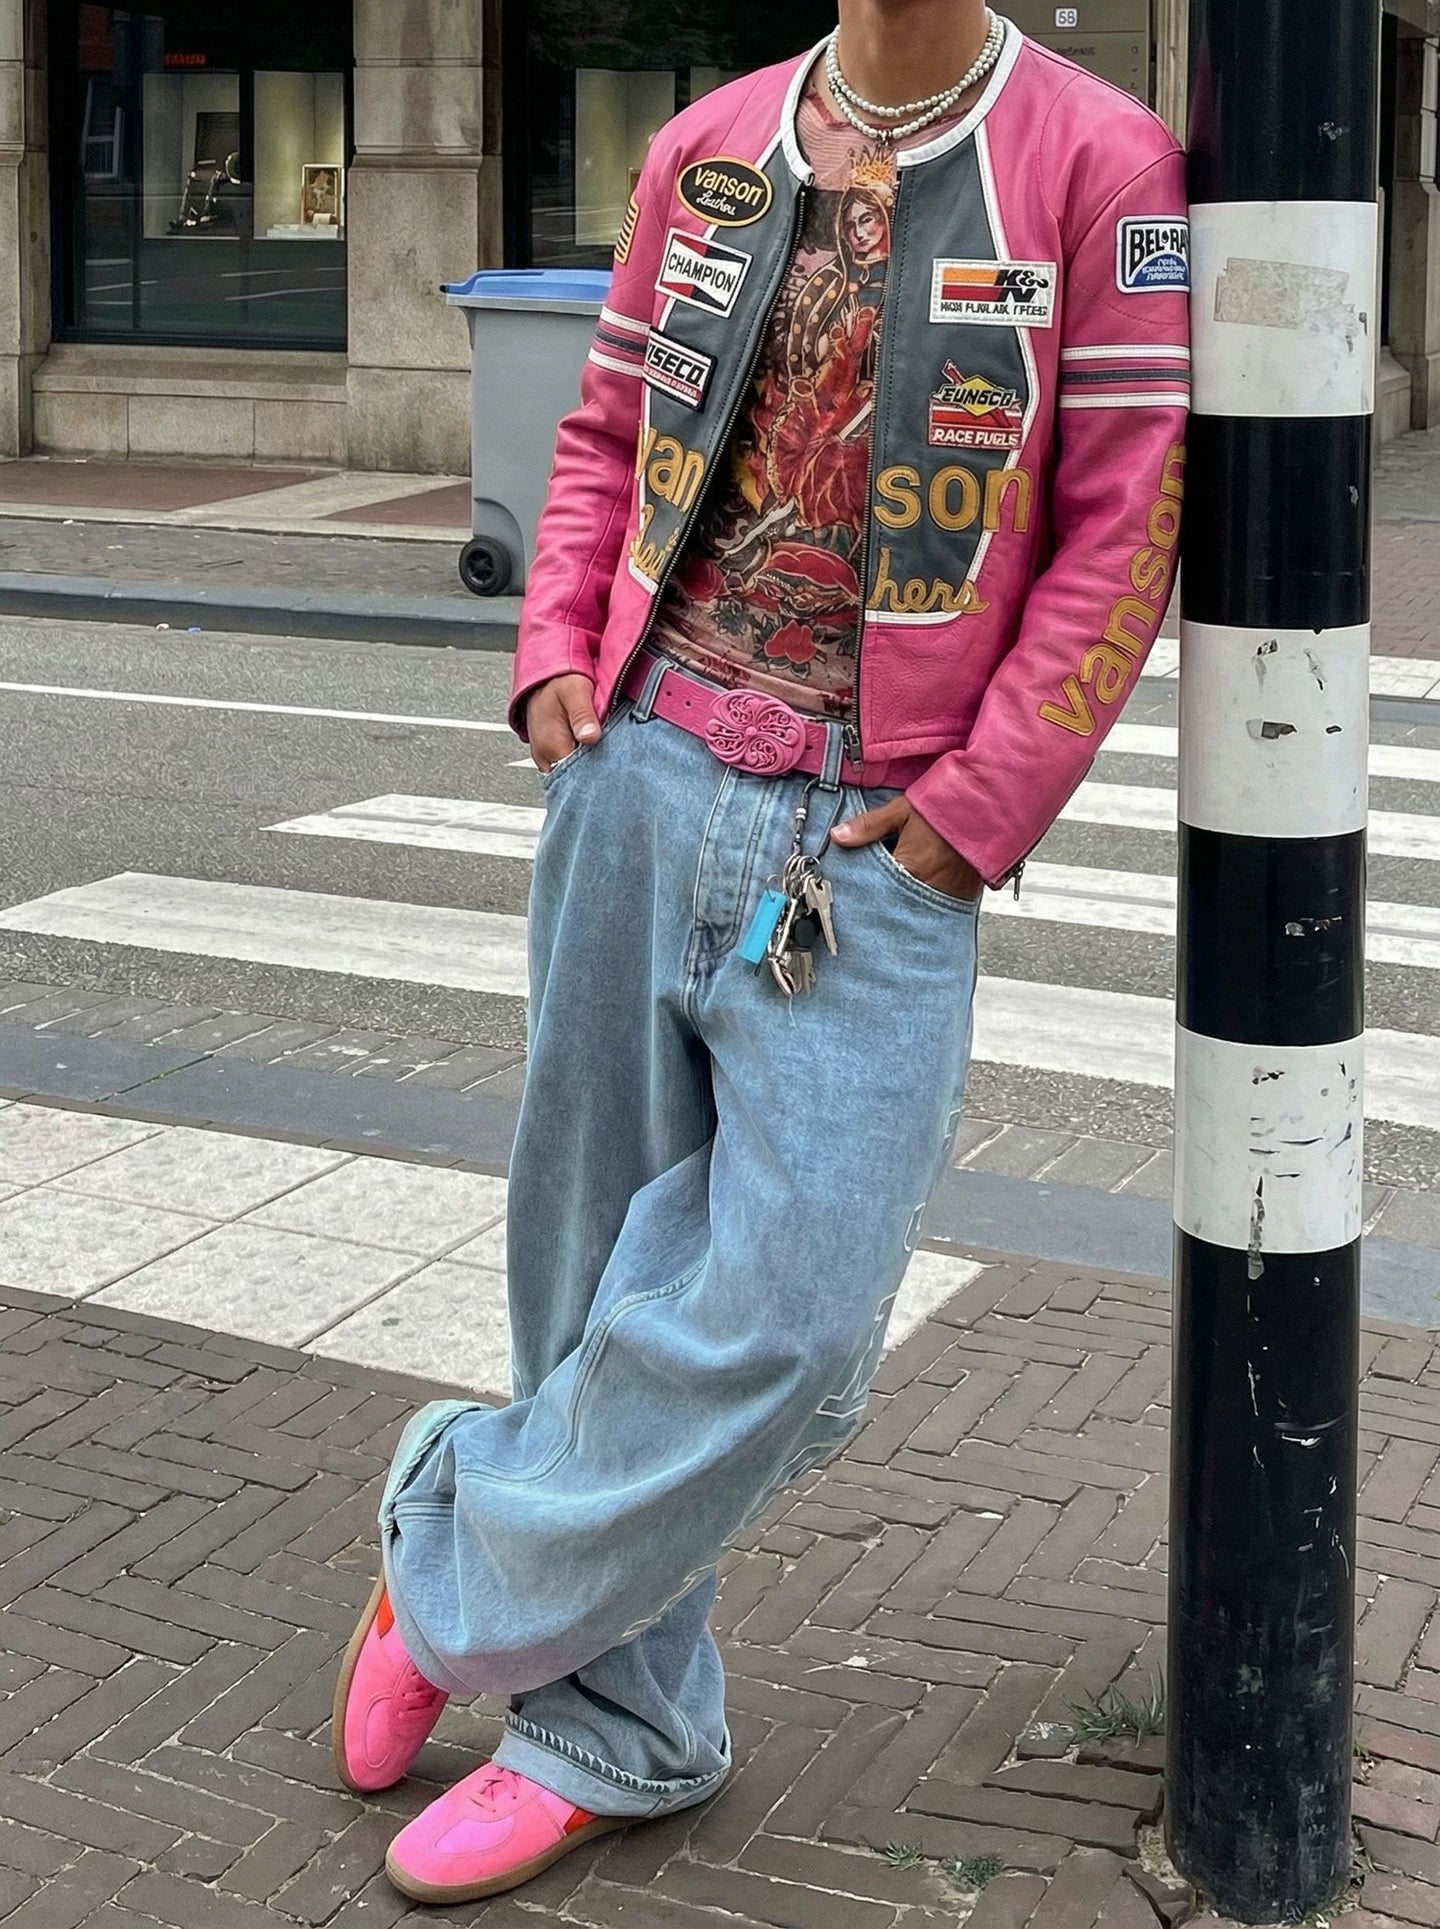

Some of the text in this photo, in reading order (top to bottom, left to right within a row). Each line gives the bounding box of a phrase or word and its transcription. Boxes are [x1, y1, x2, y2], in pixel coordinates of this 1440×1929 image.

[694, 167, 764, 206] vanson
[668, 252, 736, 293] CHAMPION
[931, 428, 974, 445] RACE
[873, 465, 1033, 533] son
[1038, 441, 1187, 737] vanson
